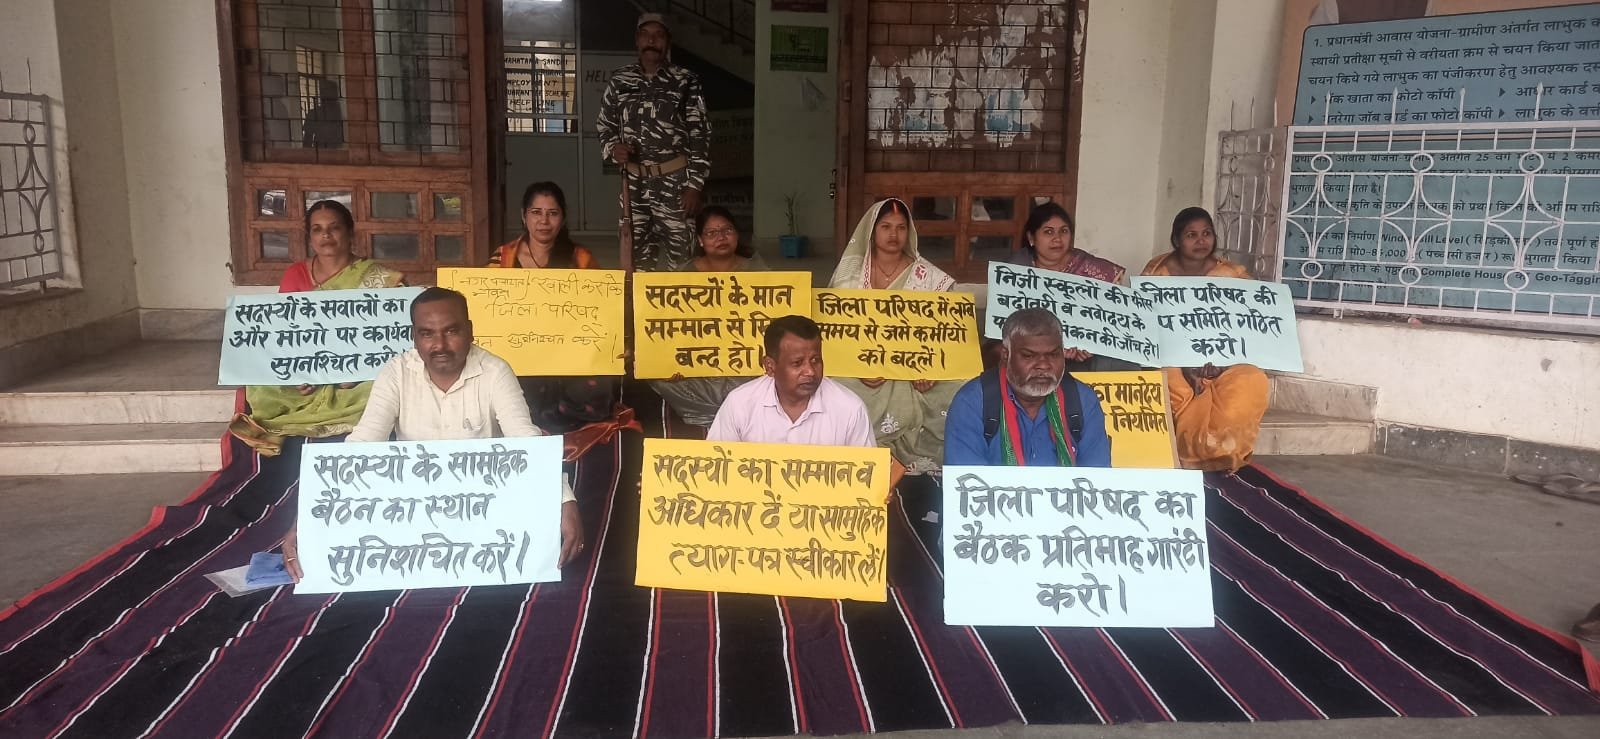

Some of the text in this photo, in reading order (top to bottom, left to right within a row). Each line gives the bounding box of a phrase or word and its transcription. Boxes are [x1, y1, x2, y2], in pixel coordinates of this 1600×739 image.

[1326, 31, 1374, 46] प्रधानमंत्री
[1376, 31, 1412, 43] आवास
[1500, 19, 1540, 34] अंतर्गत
[1543, 18, 1587, 34] लाभुक
[1310, 53, 1341, 67] स्थायी
[1343, 52, 1377, 65] प्रतीक्षा
[1379, 49, 1404, 65] सूची
[1406, 48, 1418, 61] से
[1420, 46, 1460, 60] वरीयता
[1463, 47, 1486, 58] क्रम
[1487, 42, 1500, 57] से
[1502, 44, 1535, 55] चयन
[1537, 39, 1571, 54] किया
[1308, 76, 1334, 86] चयन
[1336, 70, 1361, 84] किये
[1363, 70, 1380, 83] गये
[1383, 71, 1420, 85] लाभुक
[1421, 70, 1440, 81] का
[1441, 66, 1497, 80] पंजीकरण
[1498, 64, 1518, 80] हेतु
[1520, 63, 1580, 76] आवश्यक
[1558, 80, 1590, 96] कार्ड
[1347, 87, 1457, 104] खाता का फोटो कॉपी
[1411, 111, 1428, 122] का
[1463, 106, 1494, 120] कॉपी
[1560, 104, 1576, 117] के
[993, 265, 1040, 291] निजी
[1043, 275, 1102, 301] स्कूलों
[1103, 285, 1131, 308] की
[1420, 267, 1471, 279] Complete
[645, 275, 795, 313] सदस्यों के मान
[815, 292, 870, 318] जिला
[873, 294, 940, 323] परिषद
[936, 296, 950, 318] में
[1190, 282, 1250, 310] परिषद
[1252, 284, 1279, 306] की
[235, 292, 408, 326] सदस्यों के सवालों का
[1060, 301, 1147, 333] व नवोदय के
[1179, 305, 1233, 333] समिति
[1234, 307, 1283, 338] गठित
[229, 325, 272, 349] और
[334, 325, 360, 348] पर
[644, 310, 746, 342] सम्मान से
[816, 322, 861, 342] समय
[863, 317, 879, 344] से
[880, 320, 913, 342] जमे
[1099, 326, 1121, 350] की
[674, 346, 725, 374] बन्द
[857, 344, 887, 367] को
[313, 443, 529, 492] सदस्यों के सामूहिक
[653, 445, 877, 493] सदस्यों का सम्मान व
[382, 498, 423, 524] का
[424, 492, 498, 529] स्थान
[648, 489, 887, 544] अधिकार दें या सामुहिक
[954, 473, 1200, 533] जिला परिषद का
[783, 536, 864, 582] स्वीकार
[952, 520, 1207, 575] बैठक प्रतिमाह गारंटी
